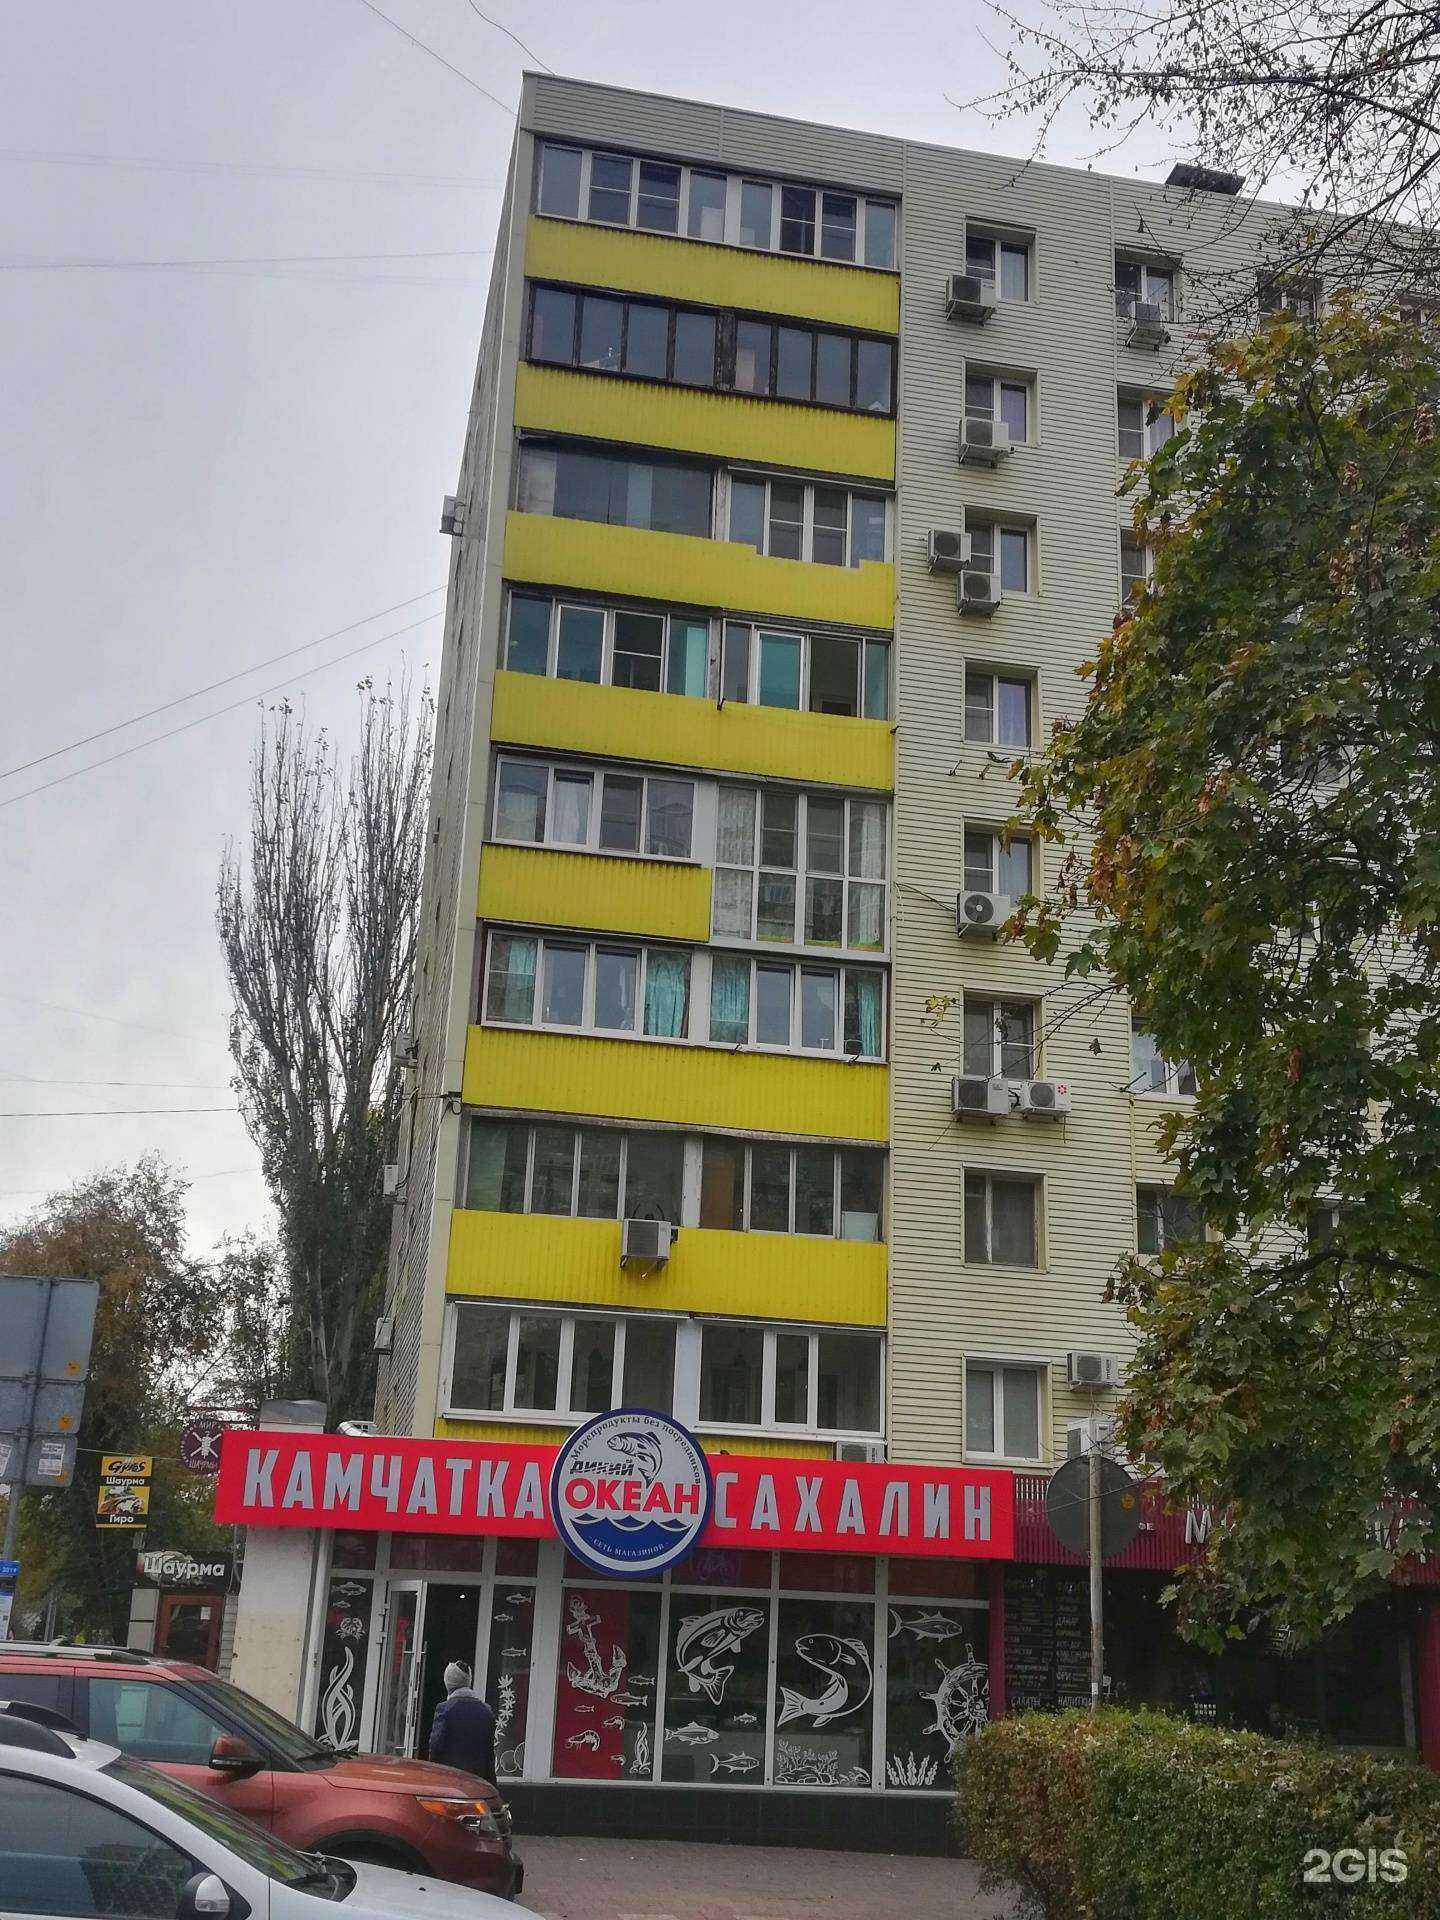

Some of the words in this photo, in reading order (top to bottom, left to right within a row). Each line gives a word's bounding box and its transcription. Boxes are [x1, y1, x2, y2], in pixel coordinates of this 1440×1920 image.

[571, 1416, 640, 1461] Морепродукты
[643, 1416, 660, 1428] без
[662, 1425, 701, 1484] посредников
[105, 1476, 145, 1486] Шаурма
[242, 1448, 545, 1520] КАМЧАТКА
[714, 1472, 991, 1541] САХАЛИН
[564, 1477, 701, 1515] ОКЕАН
[109, 1514, 134, 1525] Гиро
[143, 1557, 225, 1580] Шаурма
